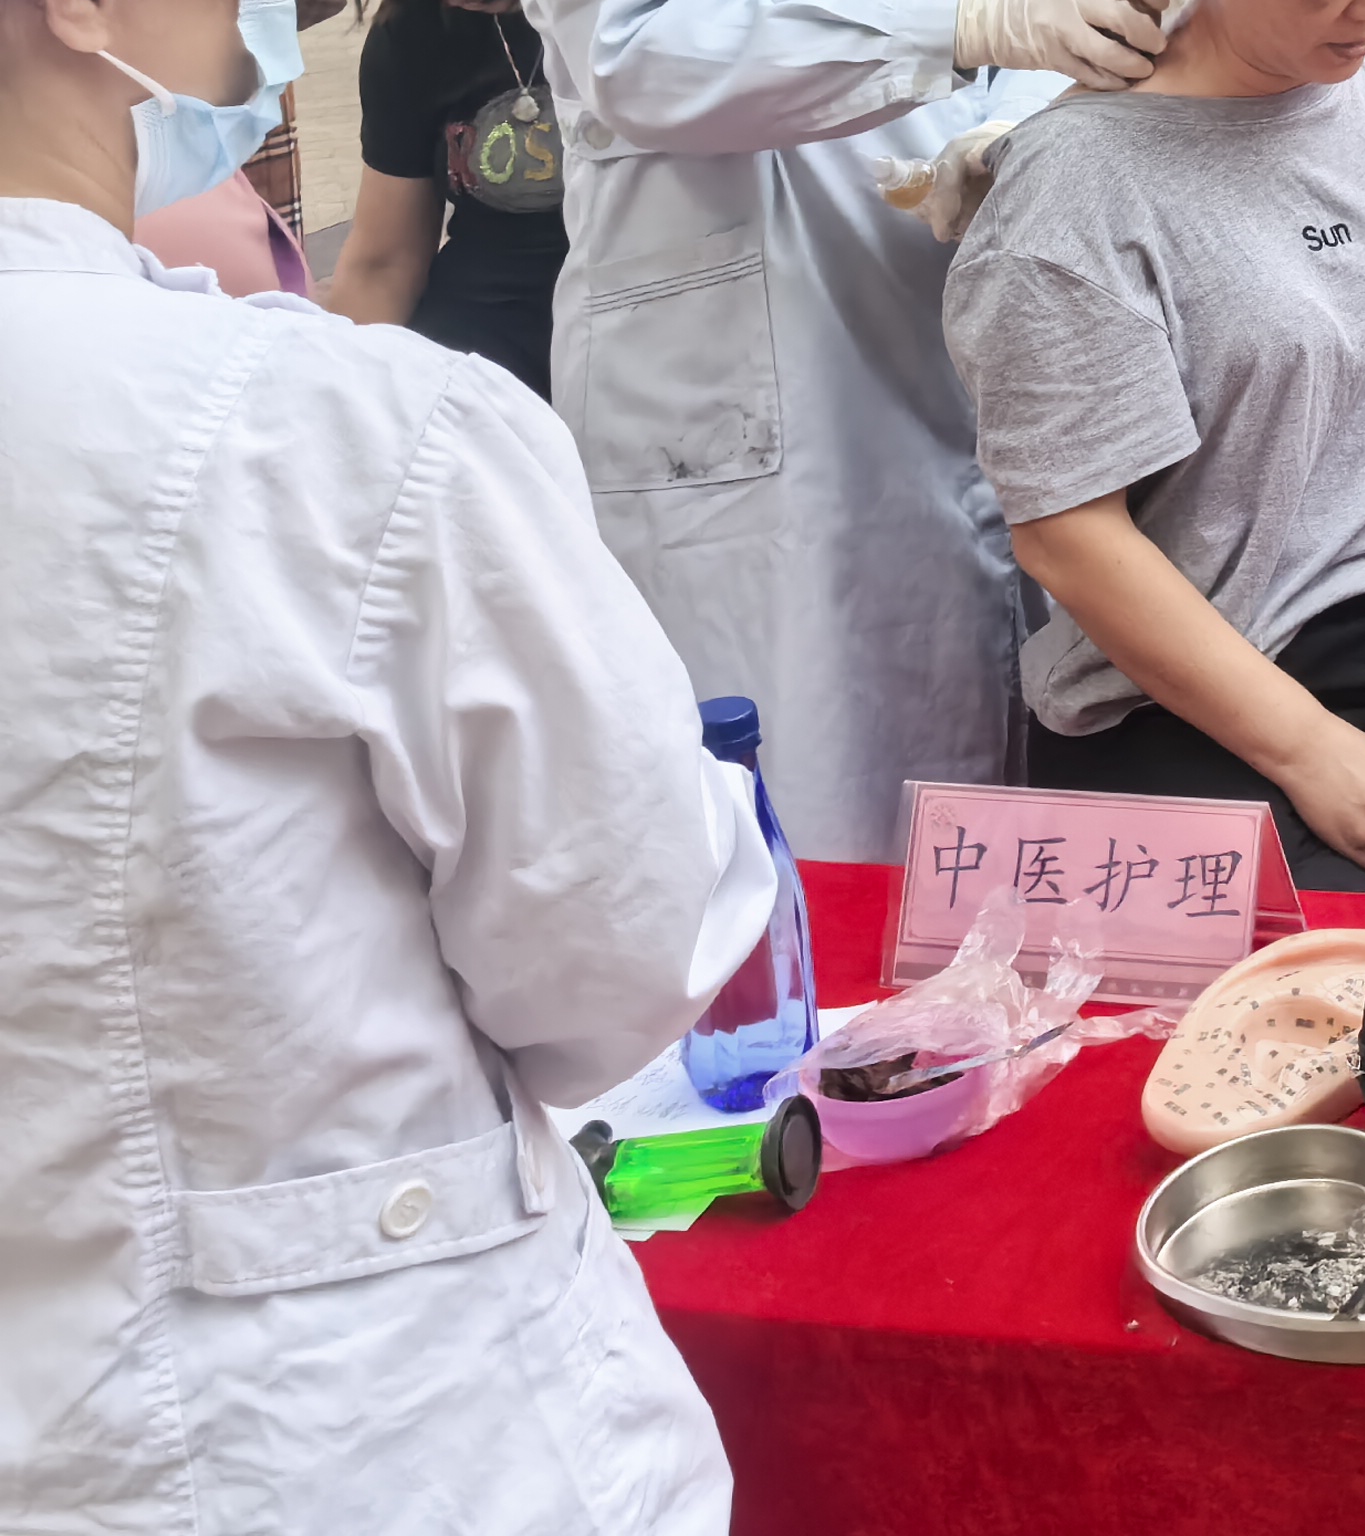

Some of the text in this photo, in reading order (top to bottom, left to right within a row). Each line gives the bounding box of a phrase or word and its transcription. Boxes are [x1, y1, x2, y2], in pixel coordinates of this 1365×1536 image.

[1302, 222, 1352, 252] Sun
[932, 825, 1243, 919] 中医护理
